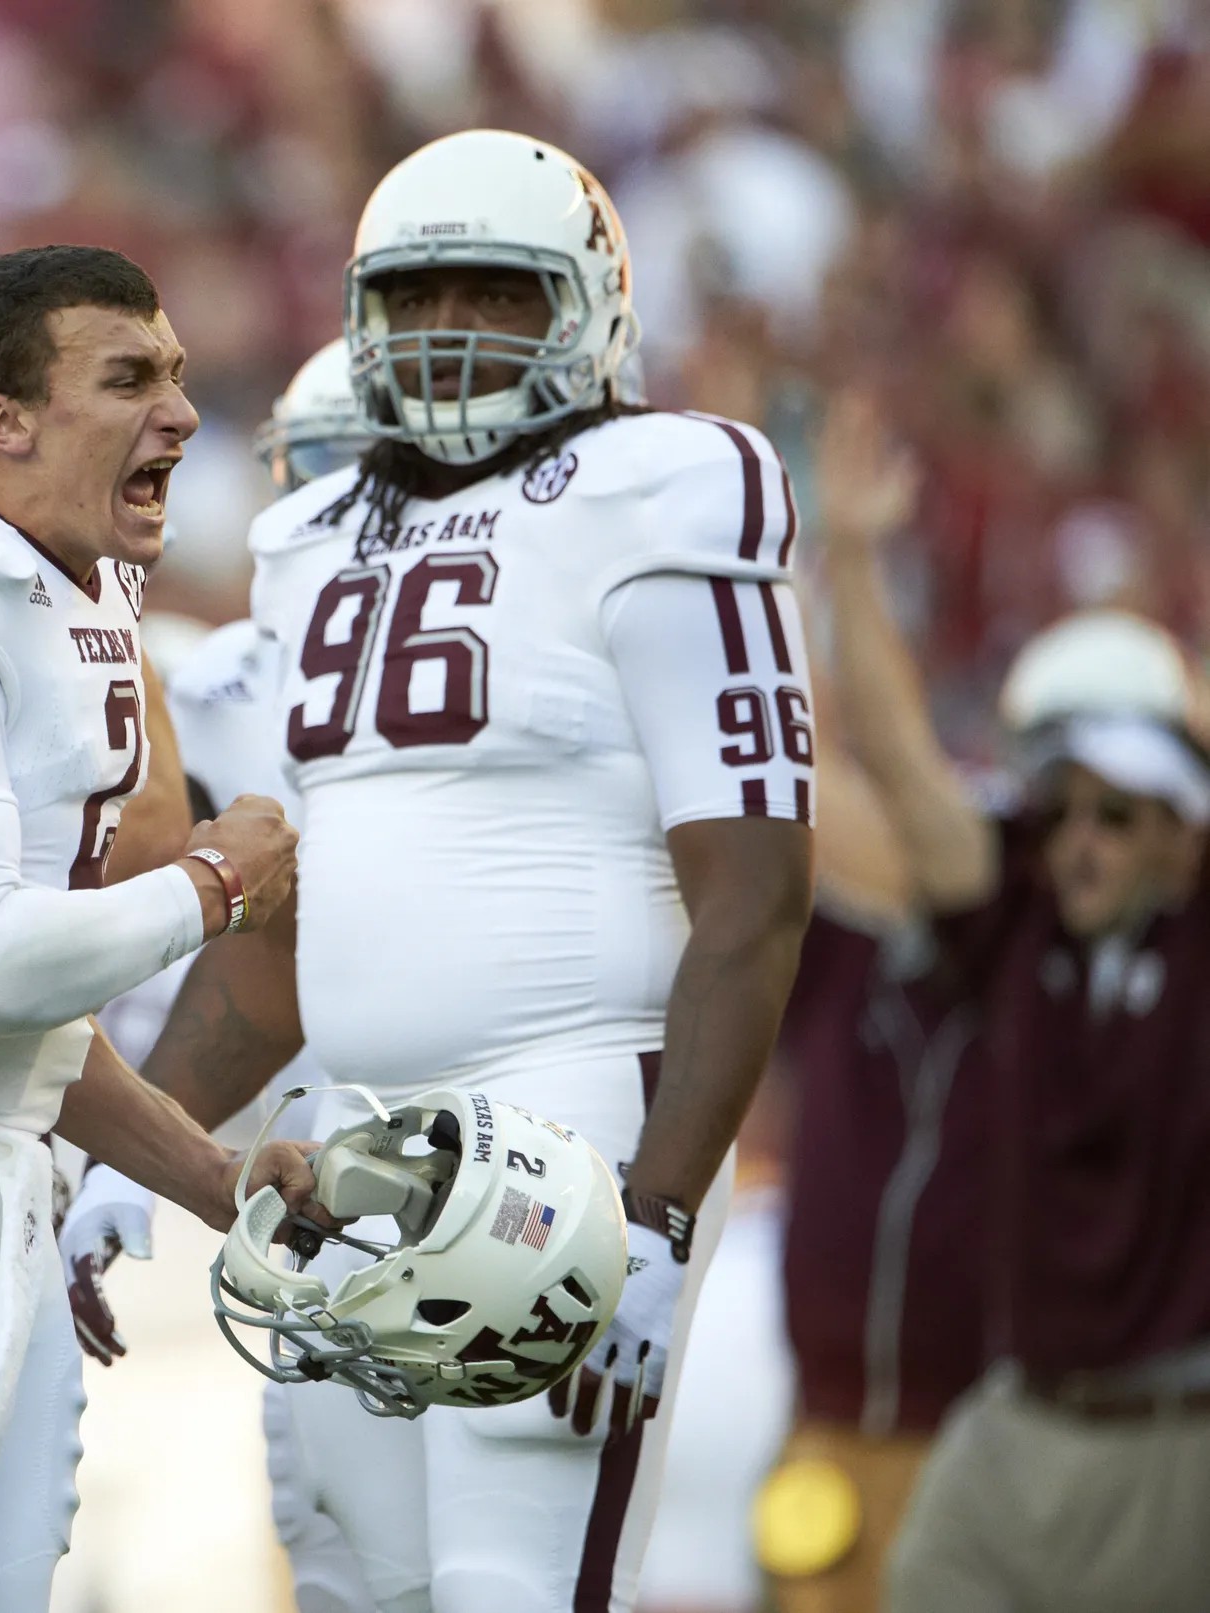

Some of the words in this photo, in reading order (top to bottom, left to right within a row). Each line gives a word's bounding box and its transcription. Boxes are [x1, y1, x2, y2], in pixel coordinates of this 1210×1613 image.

[438, 509, 502, 542] A&M
[287, 550, 499, 763] 96
[716, 685, 813, 768] 96
[68, 679, 143, 891] 2
[468, 1091, 494, 1130] TEXAS
[474, 1131, 494, 1164] A&M
[506, 1149, 547, 1179] 2
